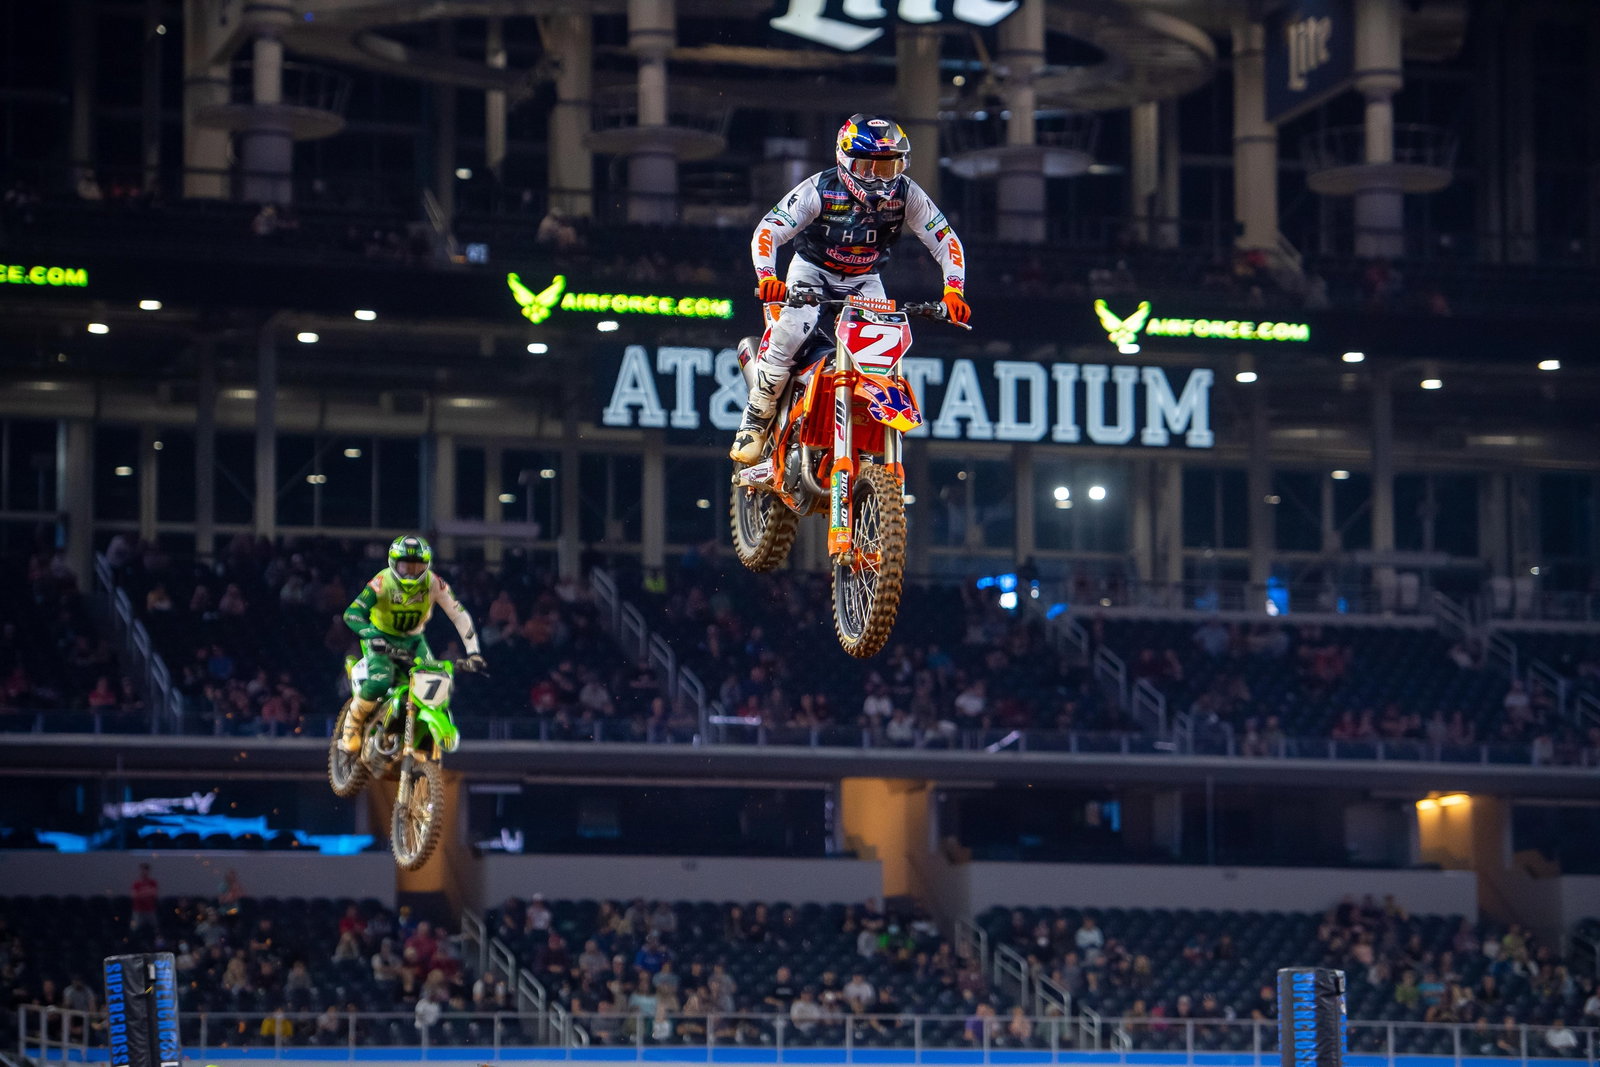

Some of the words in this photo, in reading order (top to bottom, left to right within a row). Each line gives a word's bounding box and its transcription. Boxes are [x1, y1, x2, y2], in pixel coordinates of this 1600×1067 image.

[758, 228, 774, 258] KTM
[826, 248, 854, 263] Red
[853, 251, 880, 264] Bull
[948, 237, 964, 269] KTM
[560, 293, 734, 319] AIRFORCE.COM
[852, 324, 902, 366] 2
[1146, 318, 1310, 343] AIRFORCE.COM
[899, 357, 1214, 448] TADIUM
[840, 472, 849, 527] DUNOP
[422, 679, 442, 701] 1
[105, 963, 129, 1065] SUPERCROSS
[154, 959, 179, 1061] SUPERCROSS
